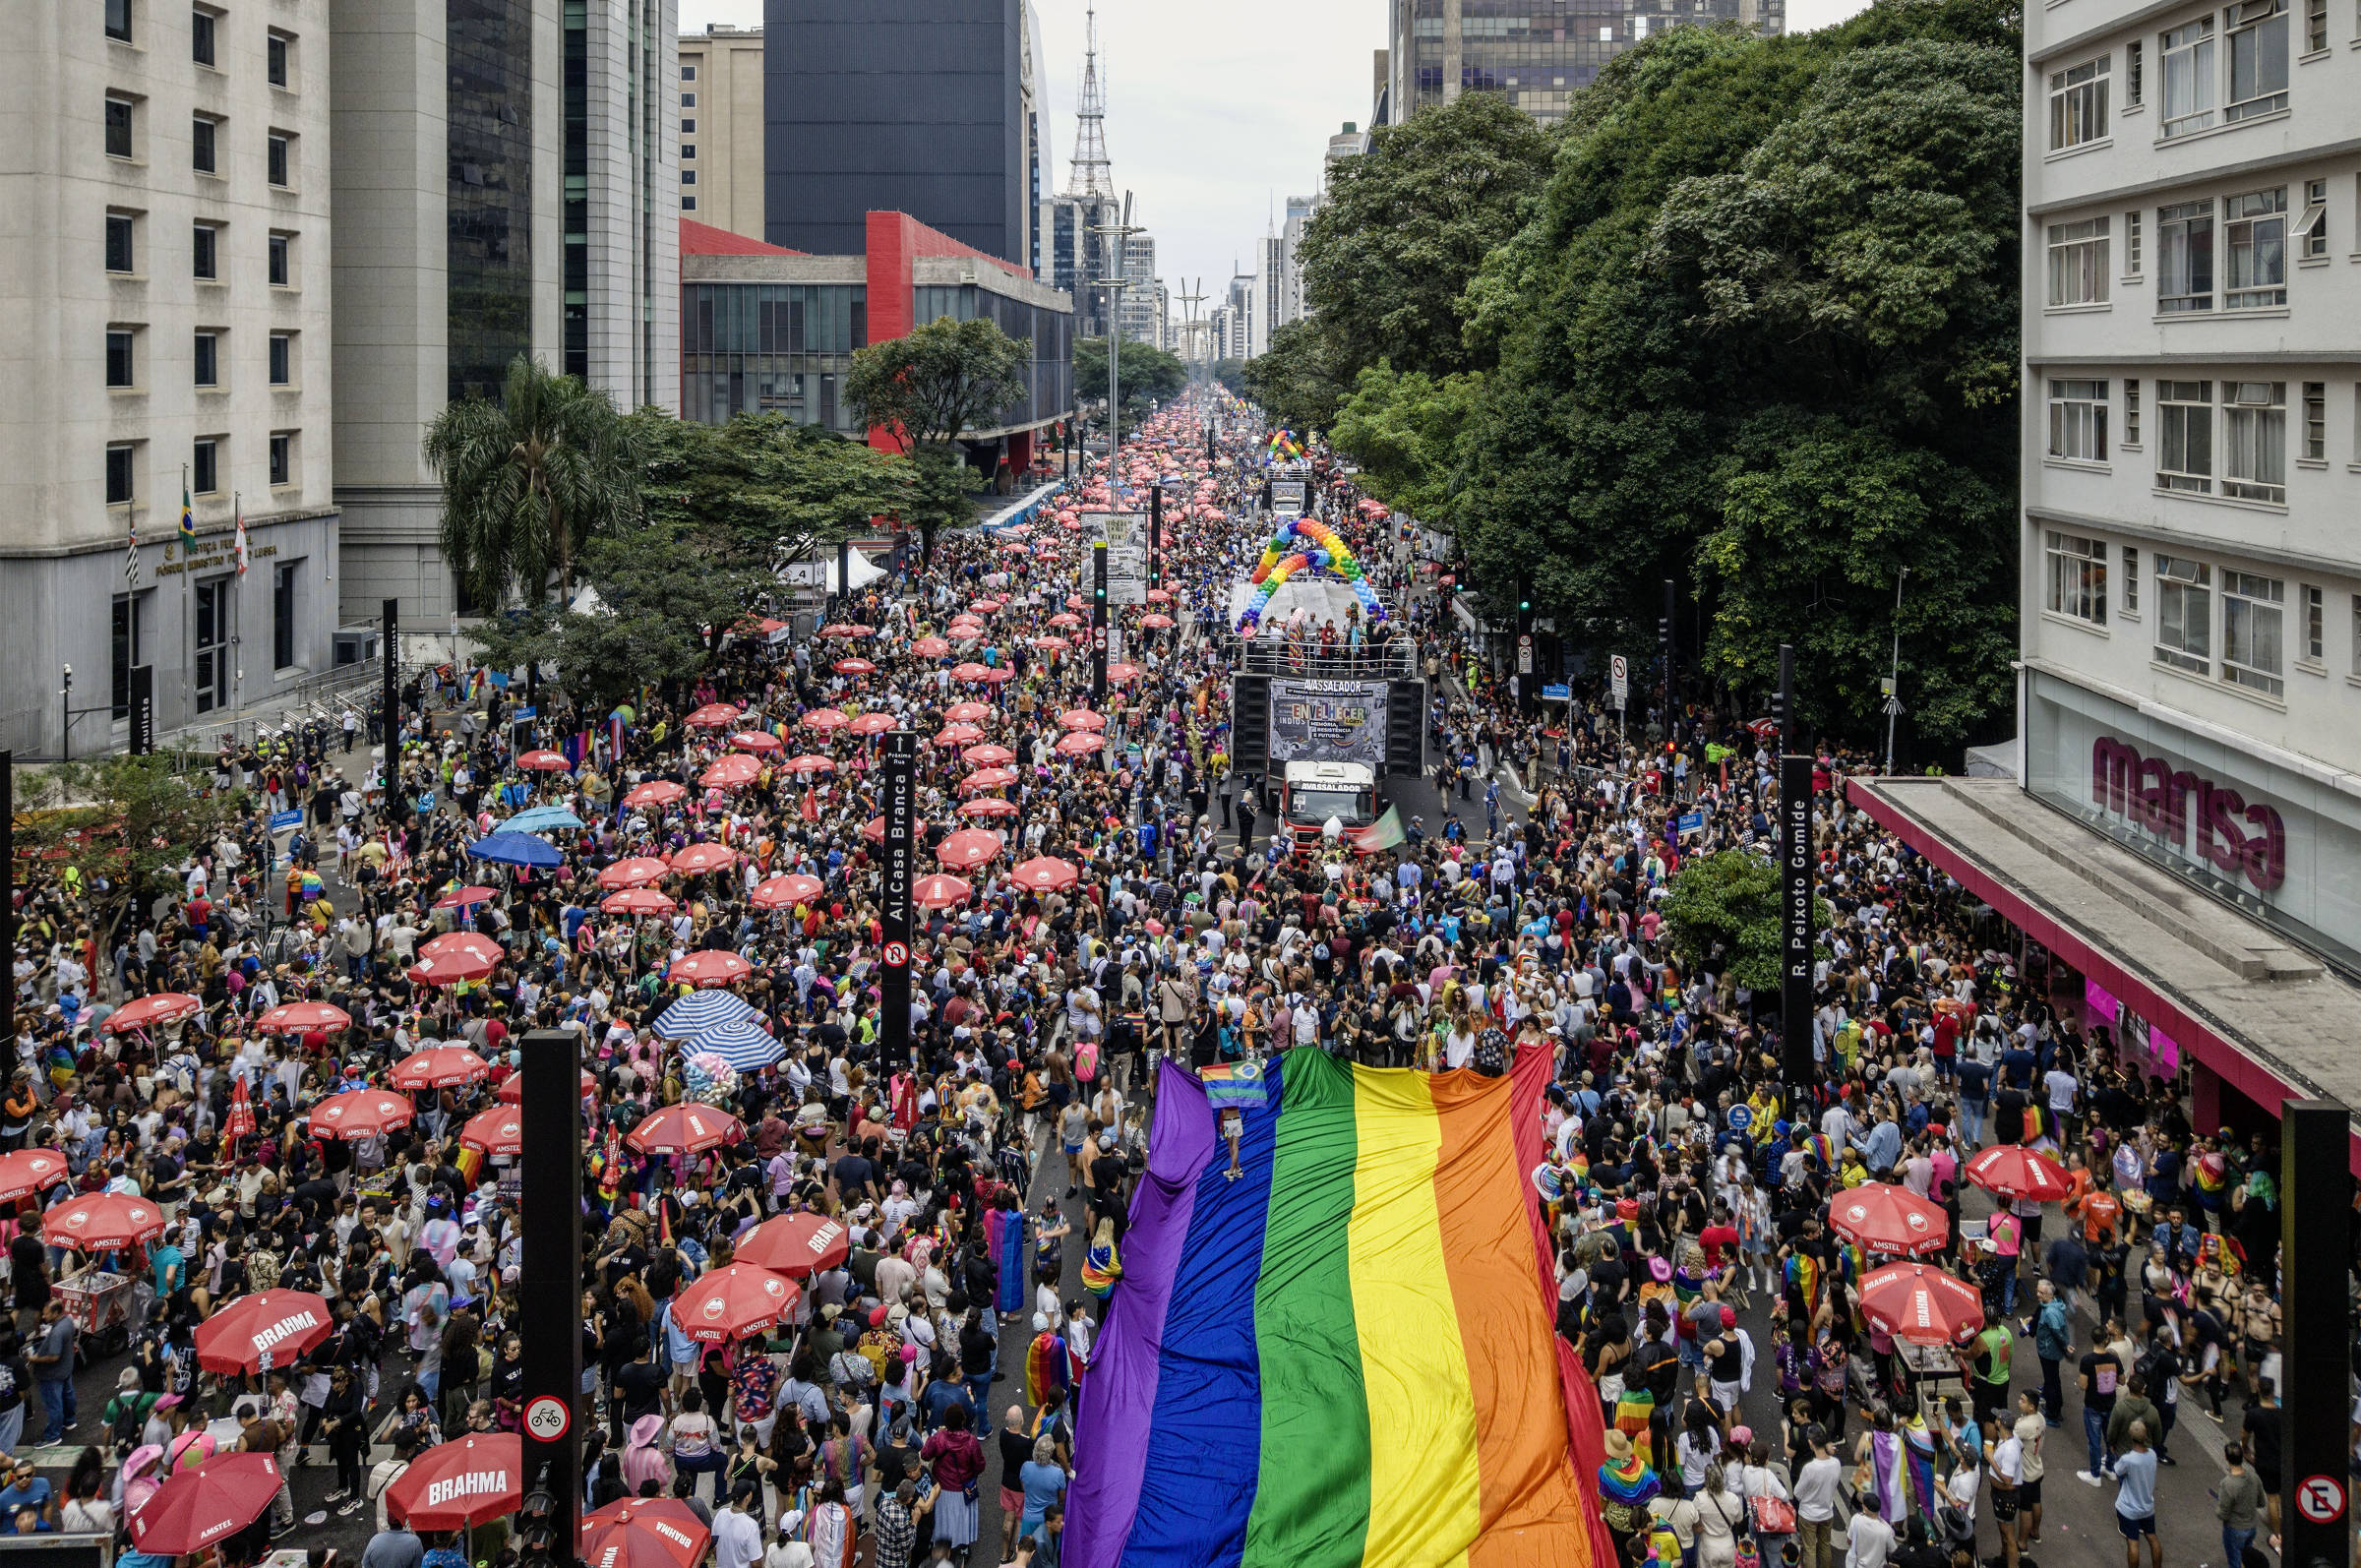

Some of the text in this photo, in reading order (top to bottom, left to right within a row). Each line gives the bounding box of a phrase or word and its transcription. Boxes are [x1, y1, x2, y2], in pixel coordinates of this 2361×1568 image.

[798, 570, 806, 578] 4
[1304, 679, 1362, 693] AVASSALADOR
[1292, 703, 1365, 721] ENVELHECER
[141, 697, 150, 755] Paulista
[1301, 783, 1361, 792] AVASSALADOR
[891, 775, 906, 839] Branca
[2092, 736, 2286, 891] marisa
[1791, 799, 1806, 977] R. Peixoto Gomide
[156, 1010, 177, 1021] AMSTEL
[122, 1019, 142, 1029] AMSTEL
[325, 1022, 342, 1031] AMSTEL
[438, 1076, 461, 1086] AMSTEL
[314, 1126, 331, 1136] AMSTEL
[386, 1119, 405, 1131] AMSTEL
[1976, 1150, 2003, 1172] BRAHMA
[44, 1172, 62, 1186] AMSTEL
[0, 1187, 26, 1200] AMSTEL
[140, 1227, 158, 1240] AMSTEL
[1836, 1223, 1854, 1241] AMSTEL
[52, 1235, 74, 1247] AMSTEL
[93, 1238, 122, 1247] AMSTEL
[1873, 1241, 1900, 1251] AMSTEL
[1919, 1238, 1941, 1250] AMSTEL
[1864, 1272, 1897, 1291] BRAHMA
[62, 1291, 82, 1301] BRAHMA
[1940, 1276, 1975, 1302] BRAHMA
[784, 1297, 798, 1314] AMSTEL
[1915, 1290, 1931, 1328] BRAHMA
[252, 1310, 318, 1353] BRAHMA
[742, 1319, 770, 1335] AMSTEL
[695, 1330, 721, 1340] AMSTEL
[428, 1470, 508, 1506] BRAHMA
[200, 1518, 233, 1539] AMSTEL
[656, 1521, 693, 1549] BRAHMA
